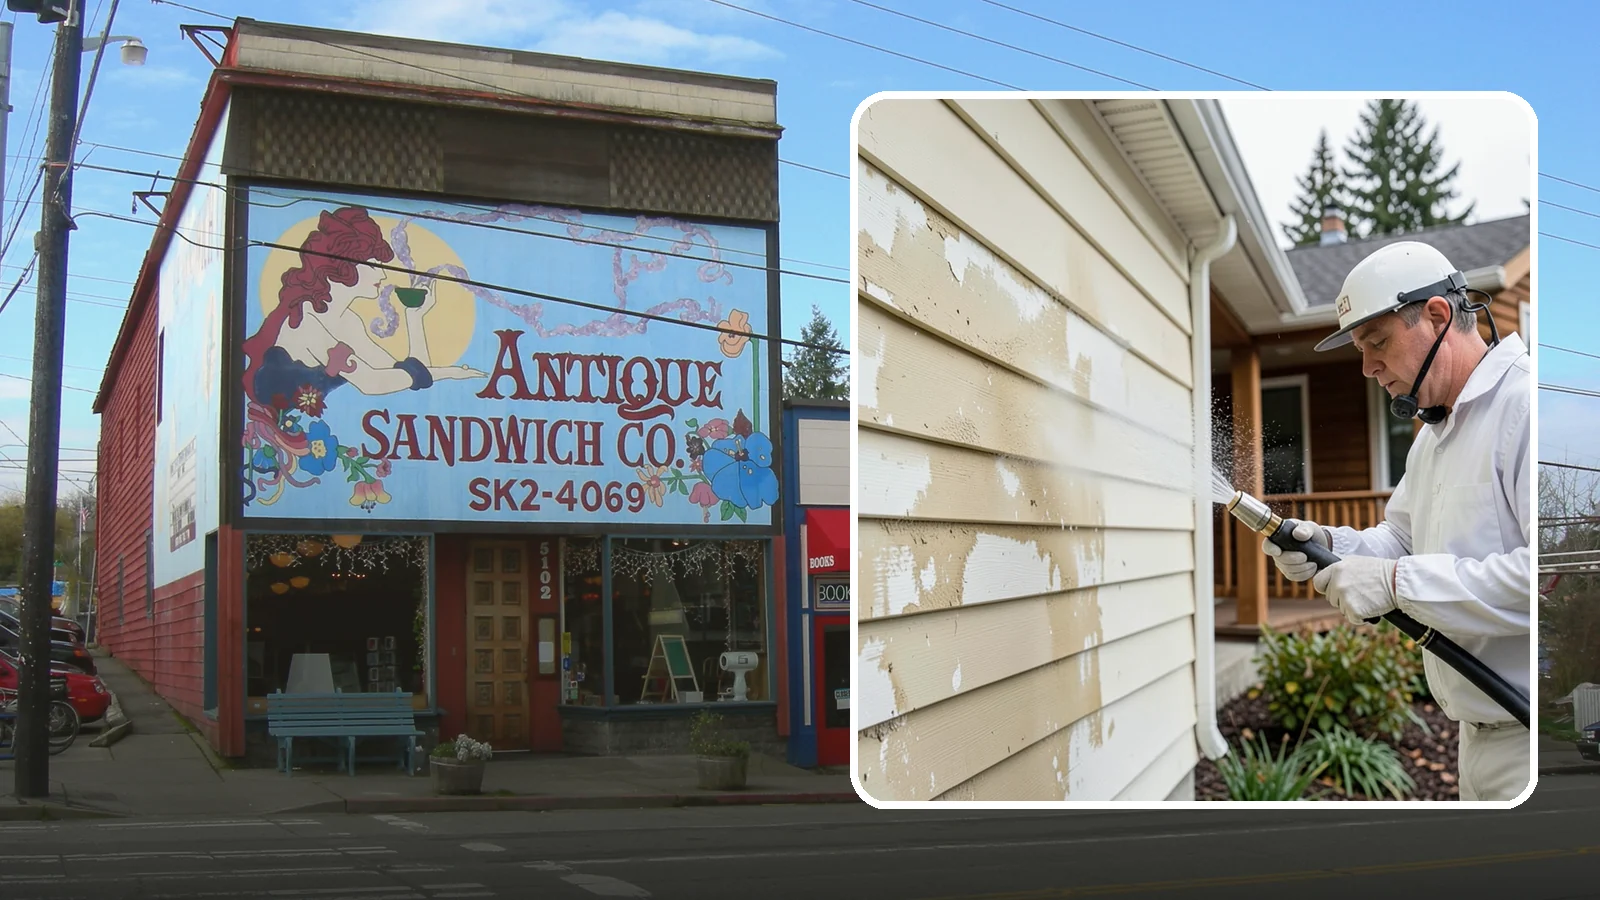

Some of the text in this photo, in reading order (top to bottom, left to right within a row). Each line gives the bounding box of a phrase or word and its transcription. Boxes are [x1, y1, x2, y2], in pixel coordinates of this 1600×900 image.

[475, 329, 723, 421] ANTIQUE
[361, 408, 685, 469] SANDWICH CO.
[468, 476, 646, 514] SK2-4069
[539, 541, 552, 600] 5102
[809, 555, 835, 569] BOOKS
